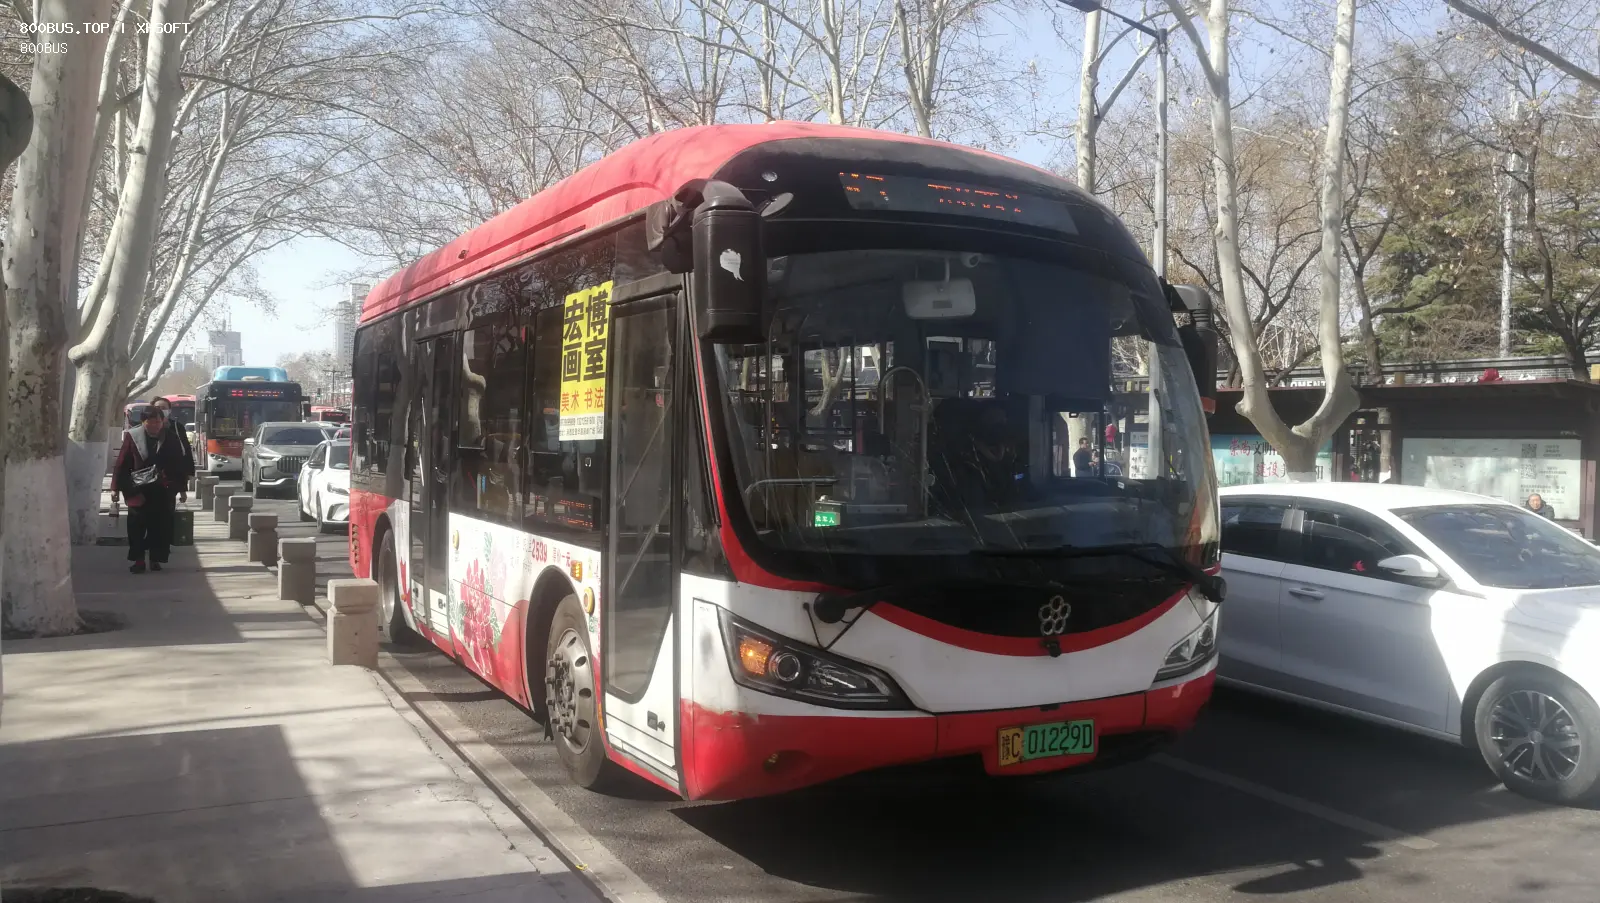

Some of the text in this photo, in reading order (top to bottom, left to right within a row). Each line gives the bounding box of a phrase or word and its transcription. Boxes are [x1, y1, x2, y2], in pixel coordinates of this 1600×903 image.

[562, 290, 609, 342] 宏博
[562, 335, 606, 383] 画室
[561, 386, 604, 412] 美术 书法
[1229, 437, 1276, 457] 崇尚文明
[531, 538, 548, 563] 2539
